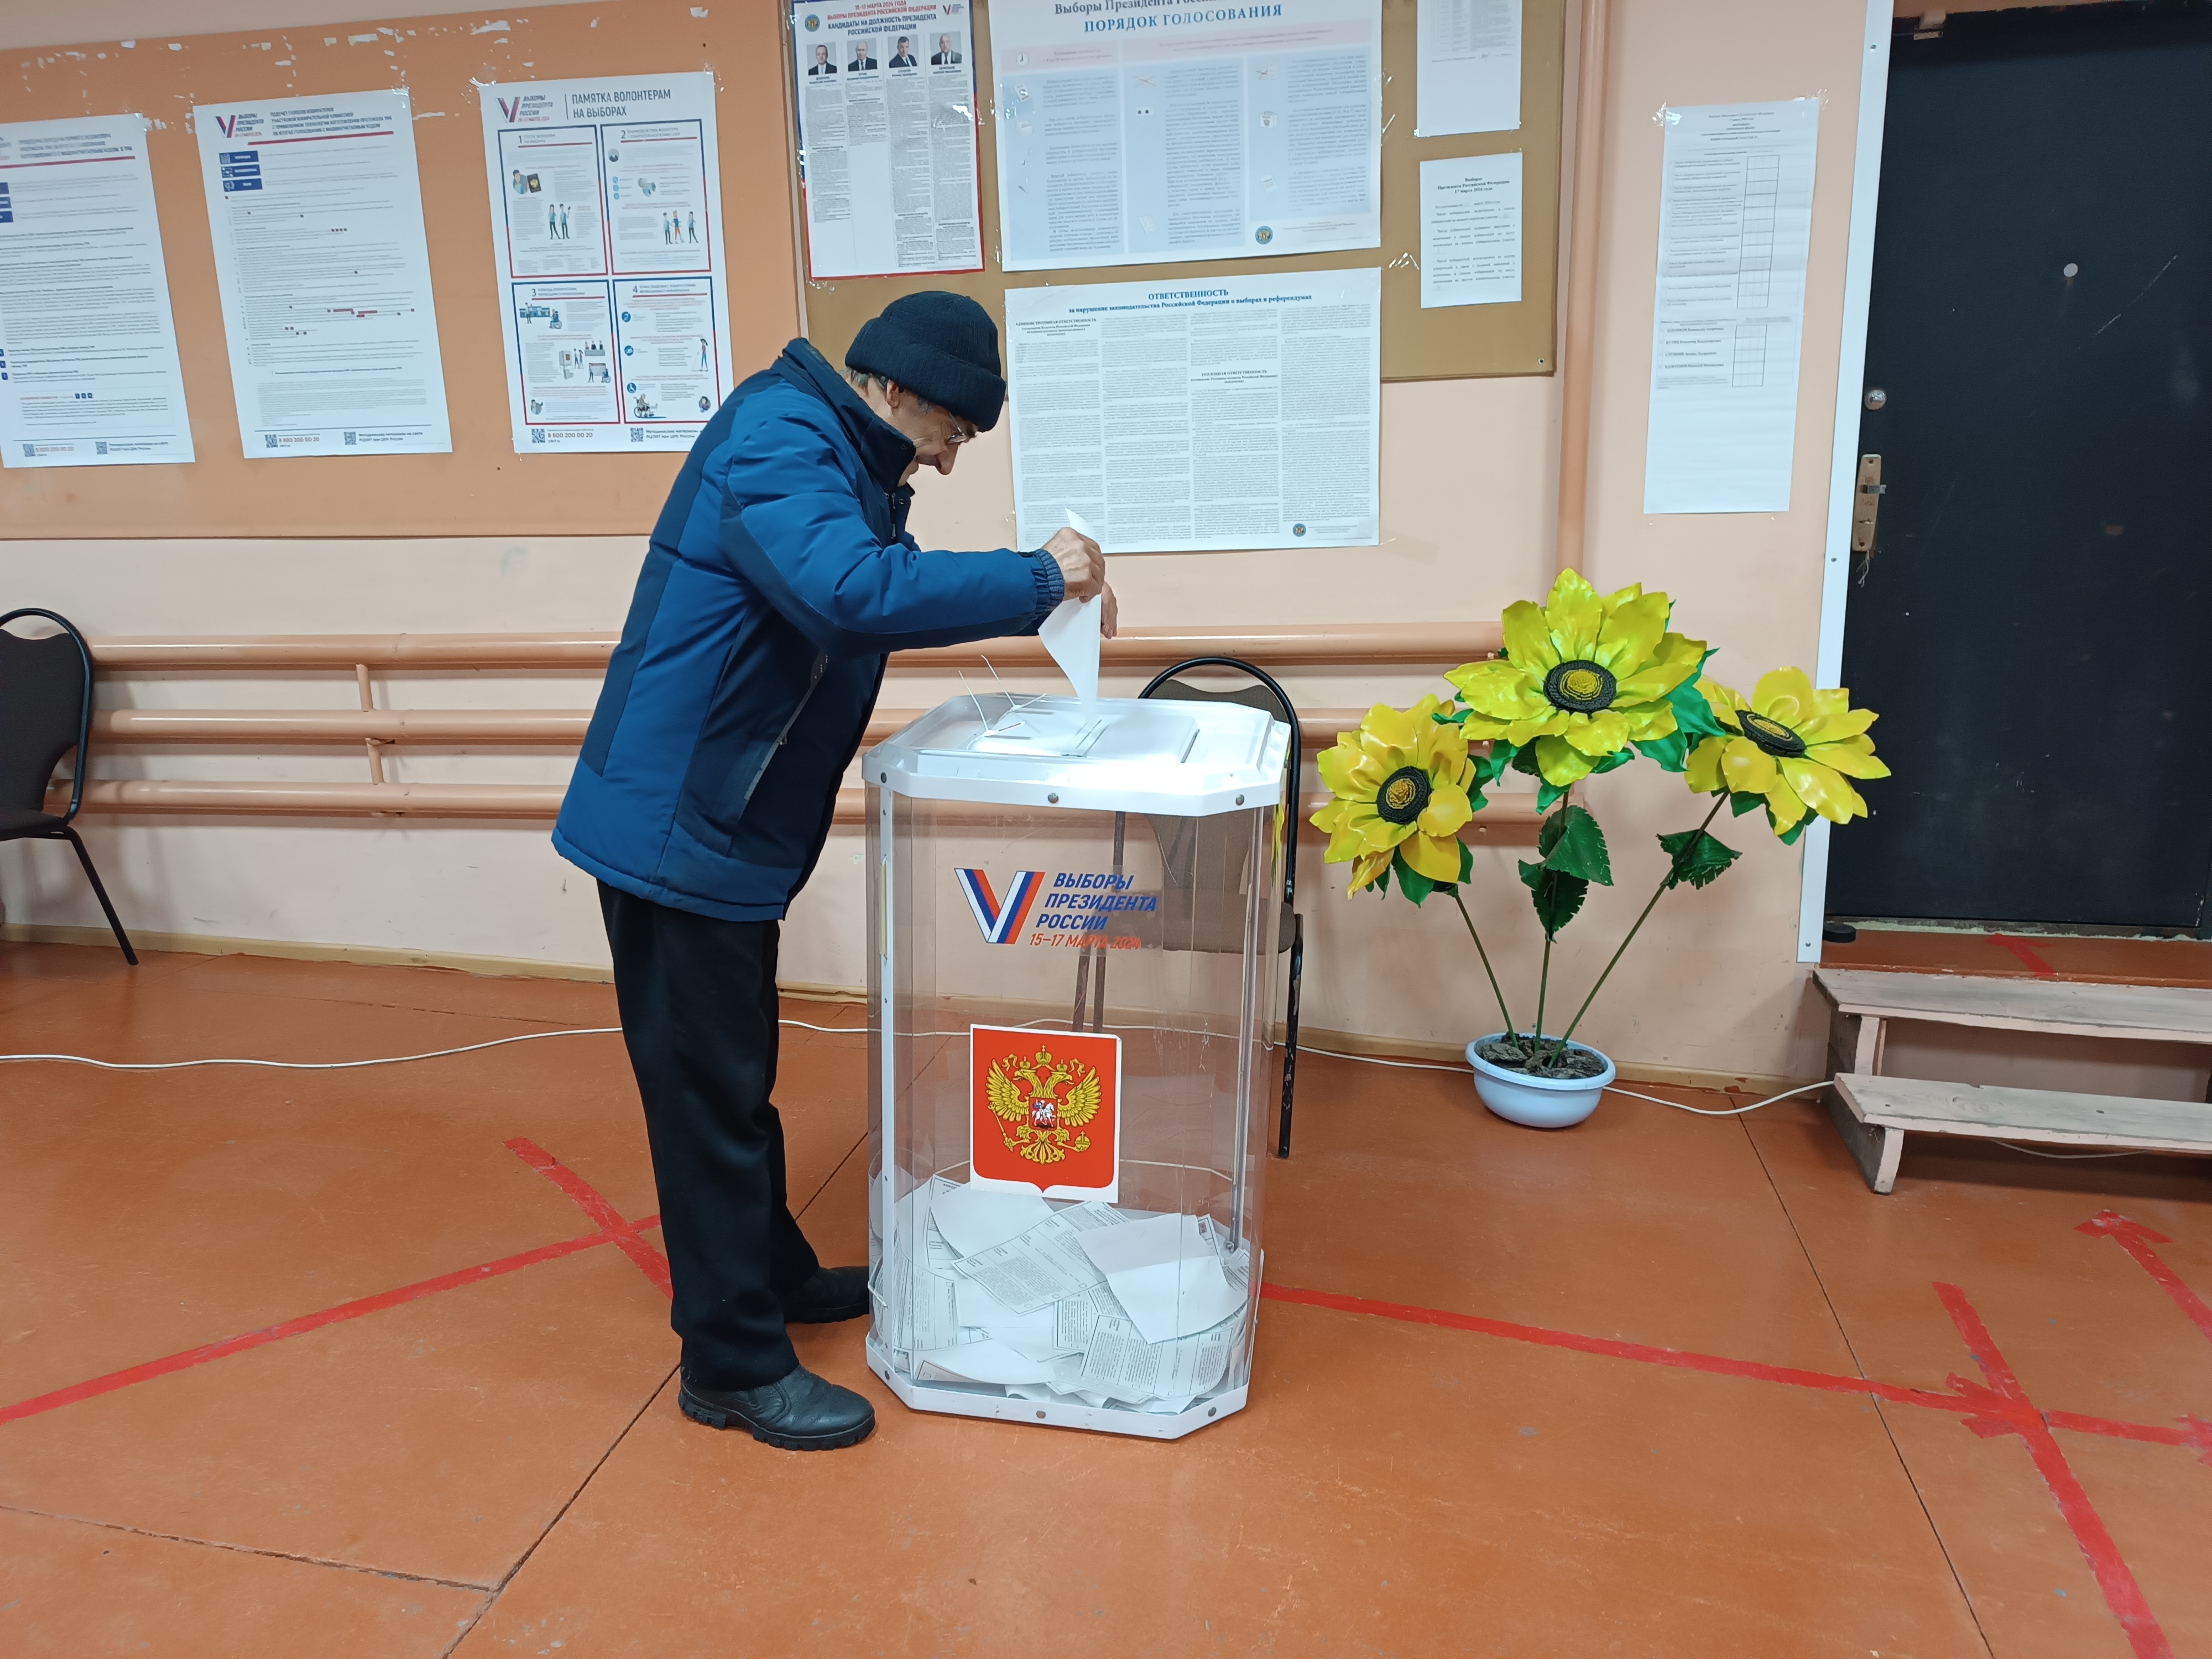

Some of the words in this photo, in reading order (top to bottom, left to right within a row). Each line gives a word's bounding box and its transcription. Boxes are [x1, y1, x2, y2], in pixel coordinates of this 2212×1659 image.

[848, 10, 876, 18] ПРЕЗИДЕНТА
[877, 6, 907, 15] РОССИЙСКОЙ
[908, 4, 937, 13] ФЕДЕРАЦИИ
[1055, 2, 1102, 16] Выборы
[1105, 0, 1173, 13] Президента
[828, 21, 860, 29] КАНДИДАТЫ
[869, 16, 901, 26] ДОЛЖНОСТЬ
[902, 13, 937, 22] ПРЕЗИДЕНТА
[1084, 15, 1158, 33] ПОРЯДОК
[1163, 4, 1282, 25] ГОЛОСОВАНИЯ
[848, 25, 883, 35] РОССИЙСКОЙ
[884, 23, 917, 32] ФЕДЕРАЦИИ
[572, 92, 612, 105] ПАМЯТКА
[614, 89, 671, 101] ВОЛОНТЕРАМ
[573, 108, 585, 118] НА
[587, 106, 628, 118] ВЫБОРАХ
[519, 135, 522, 144] 1
[621, 130, 625, 139] 2
[532, 289, 536, 297] 3
[633, 285, 638, 294] 4
[1149, 289, 1229, 300] ОТВЕТСТВЕННОСТЬ
[1269, 295, 1312, 303] референдумах
[1053, 873, 1134, 890] ВЫБОРЫ
[1045, 893, 1158, 912] ПРЕЗИДЕНТА
[1035, 913, 1109, 930] РОССИИ
[1065, 934, 1108, 949] МАРТА
[1109, 936, 1142, 950] 2024
